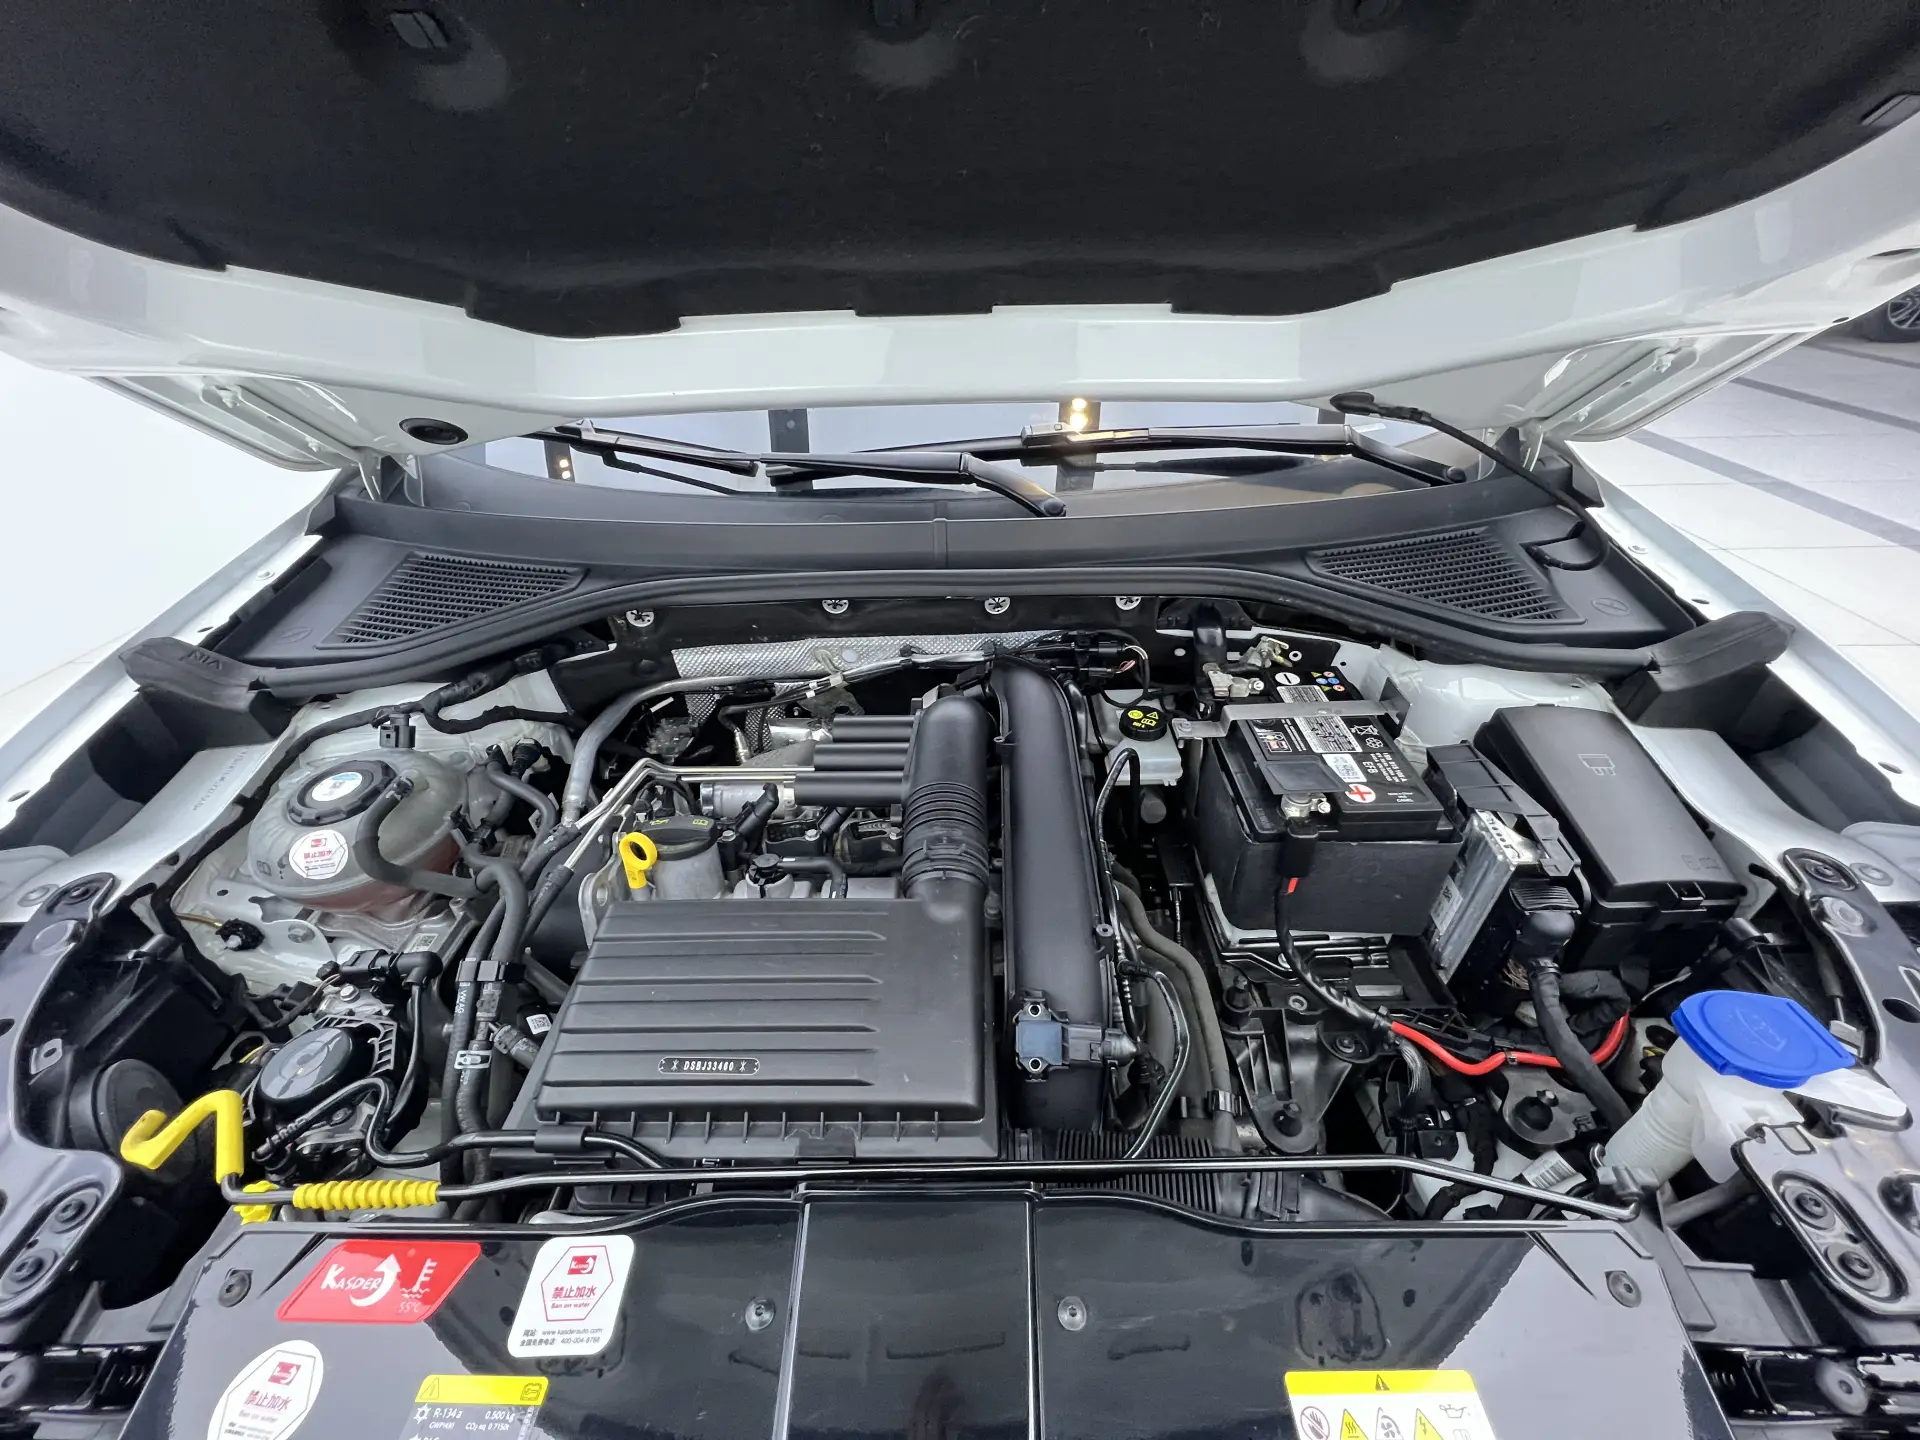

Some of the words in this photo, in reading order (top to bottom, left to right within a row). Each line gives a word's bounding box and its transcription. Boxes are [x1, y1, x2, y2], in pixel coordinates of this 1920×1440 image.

[1362, 761, 1378, 773] EFB
[552, 1285, 597, 1299] 禁止加水
[484, 1411, 505, 1420] 0.500
[505, 1411, 515, 1423] kg
